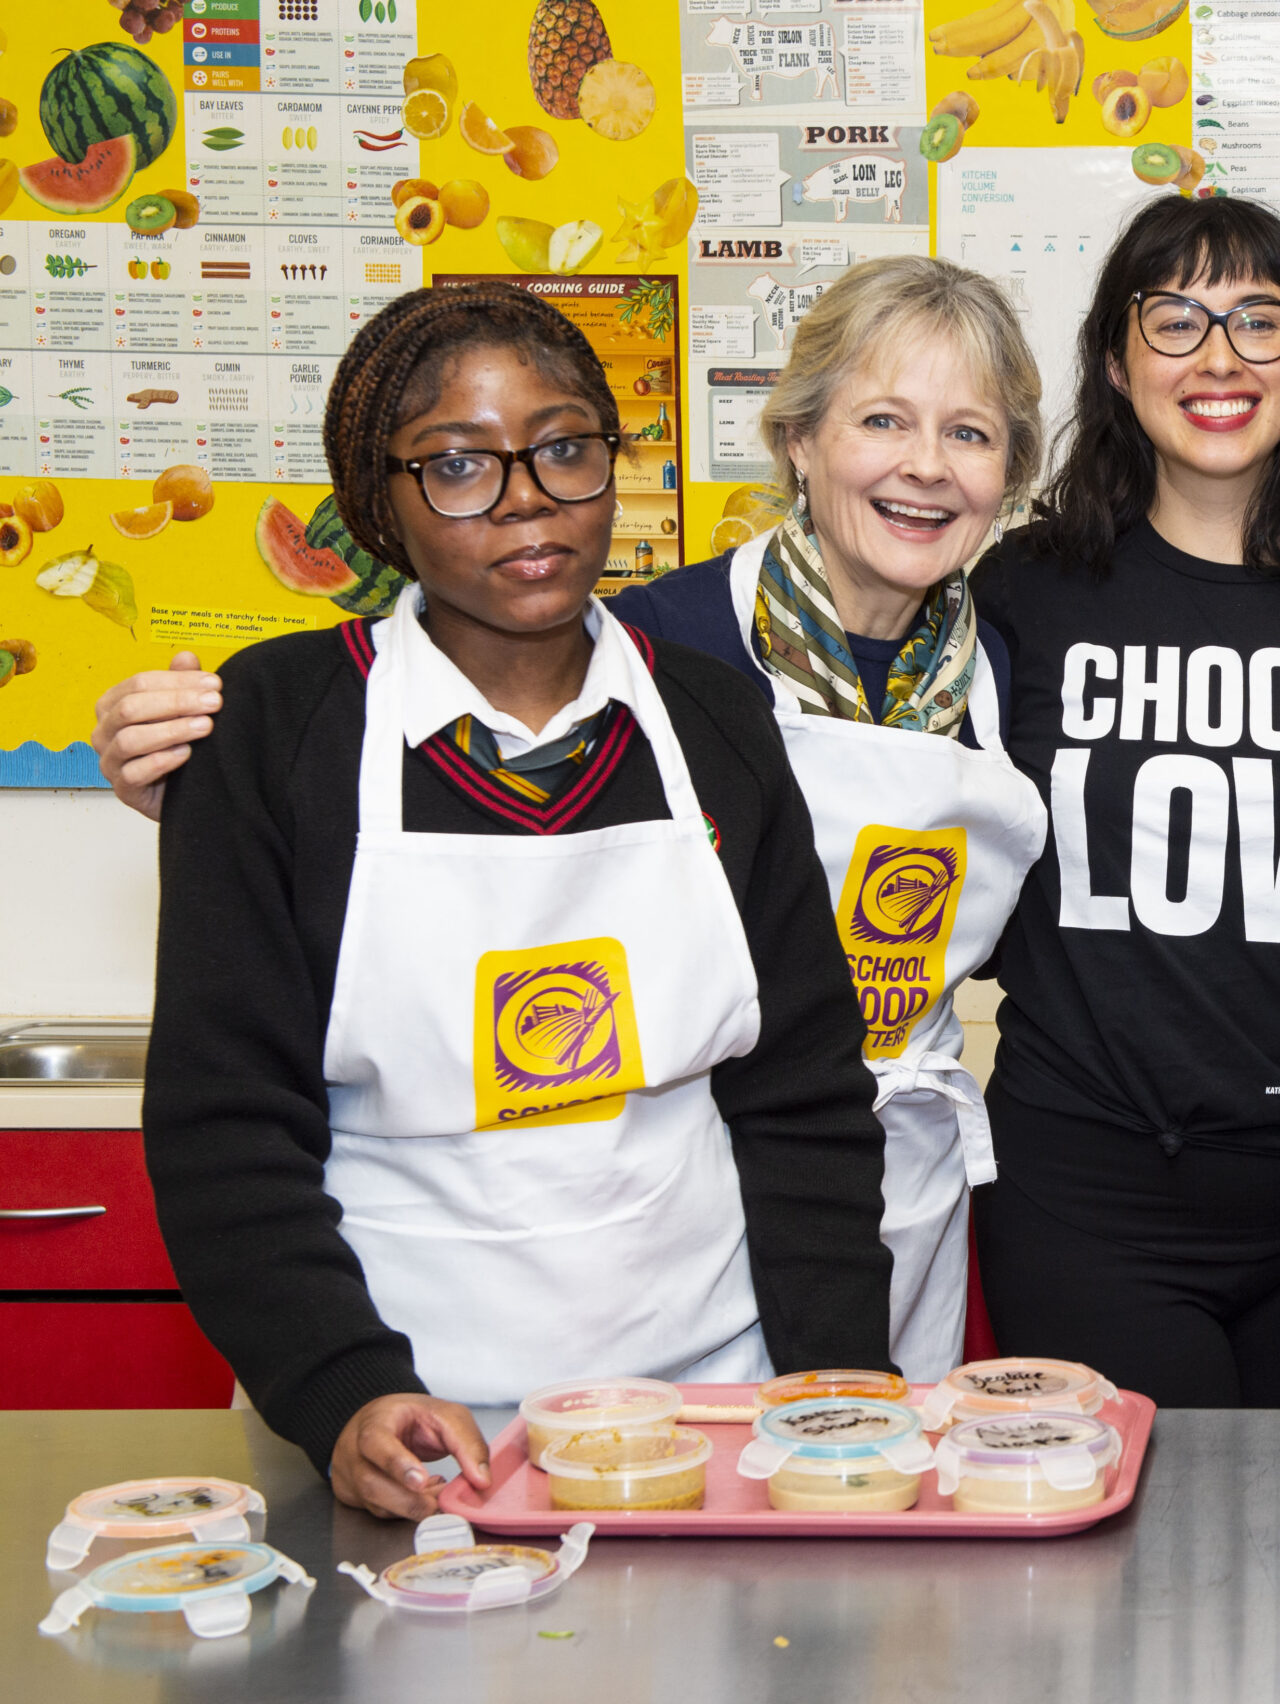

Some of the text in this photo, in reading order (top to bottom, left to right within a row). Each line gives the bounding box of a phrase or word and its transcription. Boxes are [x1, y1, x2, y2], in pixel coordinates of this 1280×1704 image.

[1217, 10, 1249, 18] Cabbage
[210, 27, 240, 36] PROTEINS
[778, 30, 802, 44] SIRLOIN
[212, 51, 232, 59] USE IN
[778, 53, 810, 67] FLANK
[200, 100, 244, 111] BAY LEAVES
[277, 102, 322, 113] CARDAMOM
[347, 104, 381, 114] CAYENNE
[1228, 120, 1249, 128] Beans
[805, 126, 889, 144] PORK
[852, 164, 876, 181] LOIN
[962, 170, 997, 180] KITCHEN
[884, 170, 902, 188] LEG
[962, 182, 995, 191] VOLUME
[1232, 186, 1266, 194] Capsicum
[856, 187, 880, 197] BELLY
[962, 194, 1014, 203] CONVERSION
[962, 204, 976, 214] AID
[49, 229, 86, 239] OREGANO
[204, 233, 246, 243] CINNAMON
[288, 234, 318, 244] CLOVES
[360, 235, 404, 246] CORIANDER
[700, 240, 783, 258] LAMB
[526, 282, 625, 294] COOKING GUIDE
[765, 284, 780, 304] NECK
[58, 360, 85, 369] THYME
[131, 361, 171, 371] TURMERIC
[215, 363, 241, 372] CUMIN
[292, 364, 320, 374] GARLIC
[290, 374, 322, 383] POWDER
[713, 371, 765, 384] Meat Roasting
[191, 610, 211, 618] meals
[226, 612, 253, 622] starchy
[257, 614, 280, 623] foods:
[150, 618, 263, 632] potatoes, pasta, rice, noodles
[855, 986, 929, 1027] OOD
